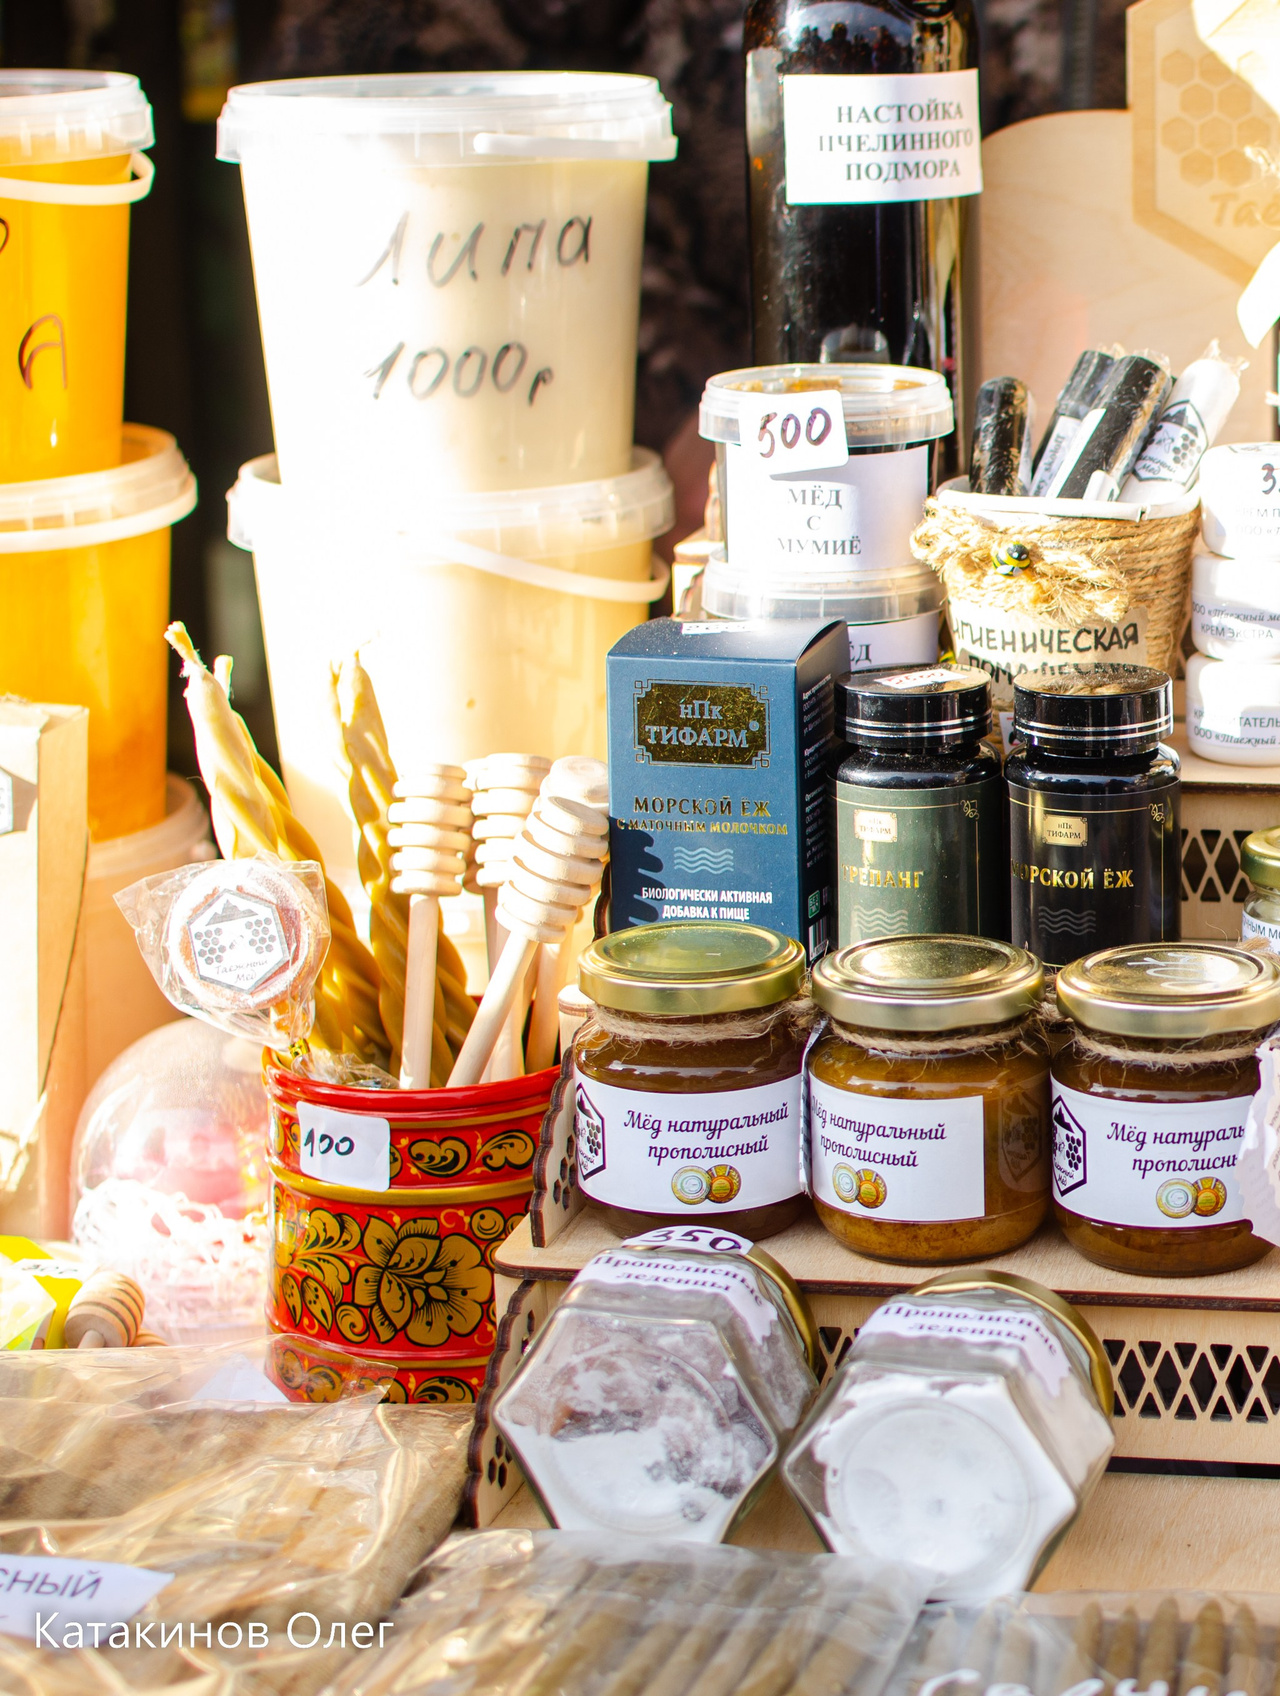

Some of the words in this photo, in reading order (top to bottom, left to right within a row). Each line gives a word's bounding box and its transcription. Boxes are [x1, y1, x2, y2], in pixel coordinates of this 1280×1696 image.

[836, 98, 963, 124] НАСТОЙКА
[818, 127, 973, 152] ПЧЕЛИННОГО
[846, 159, 961, 184] ПОДМОРА
[757, 406, 833, 459] 500
[788, 485, 843, 510] МЁД
[806, 515, 821, 531] С
[1200, 623, 1226, 637] КРЕМ
[644, 724, 749, 748] ТИФАРМ
[1193, 727, 1213, 741] ООО
[633, 795, 733, 817] МОРСКОЙ
[740, 796, 772, 818] ЁЖ
[616, 818, 626, 830] С
[628, 819, 707, 833] МАТОЧНЫМ
[709, 822, 789, 836] МОЛОЧКОМ
[1046, 829, 1081, 840] ТИФАРМ
[841, 863, 924, 889] ТРЕПАНГ
[1010, 859, 1094, 890] МОРСКОЙ
[1103, 867, 1135, 890] ЁЖ
[641, 886, 719, 902] БИОЛОГИЧЕСКИ
[719, 889, 773, 905] АКТИВНАЯ
[661, 904, 710, 920] ДОБАВКА
[710, 906, 718, 919] К
[719, 907, 750, 922] ПИЩЕ
[624, 1109, 664, 1140] Мёд
[667, 1102, 789, 1141] натуральный
[829, 1111, 947, 1143] натуральный
[303, 1127, 355, 1158] 100
[1106, 1121, 1148, 1152] Мёд
[1152, 1124, 1245, 1153] натураль
[648, 1134, 770, 1167] прополисный
[820, 1133, 919, 1168] прополисный
[639, 1229, 742, 1251] 350
[592, 1256, 763, 1306] Прополисные
[616, 1272, 732, 1292] леденцы
[883, 1305, 1058, 1356] Прополисные
